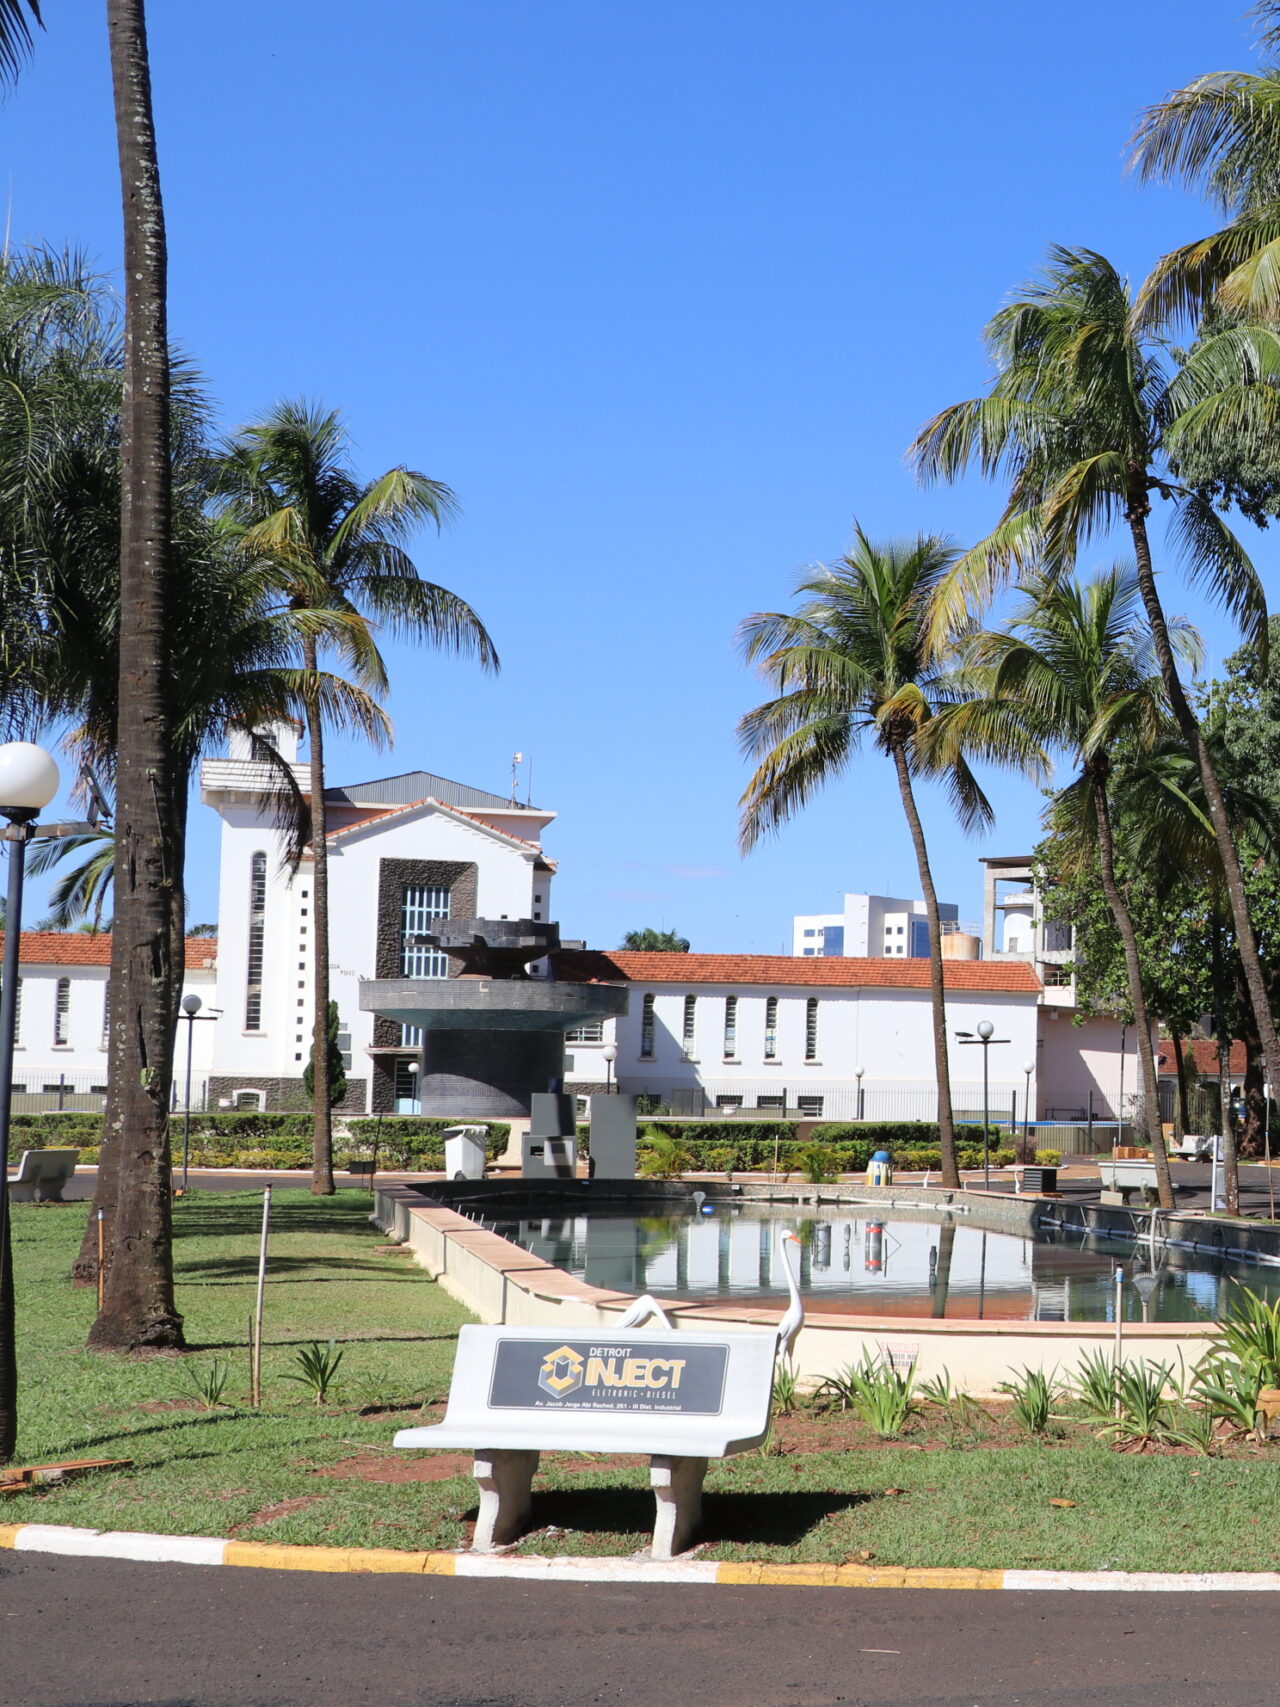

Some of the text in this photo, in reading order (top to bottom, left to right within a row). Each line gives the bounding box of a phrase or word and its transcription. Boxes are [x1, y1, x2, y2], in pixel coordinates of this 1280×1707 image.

[589, 1347, 632, 1358] DETROIT
[885, 1352, 905, 1360] SBIR
[584, 1357, 686, 1389] INJECT
[646, 1390, 676, 1399] DIESEL
